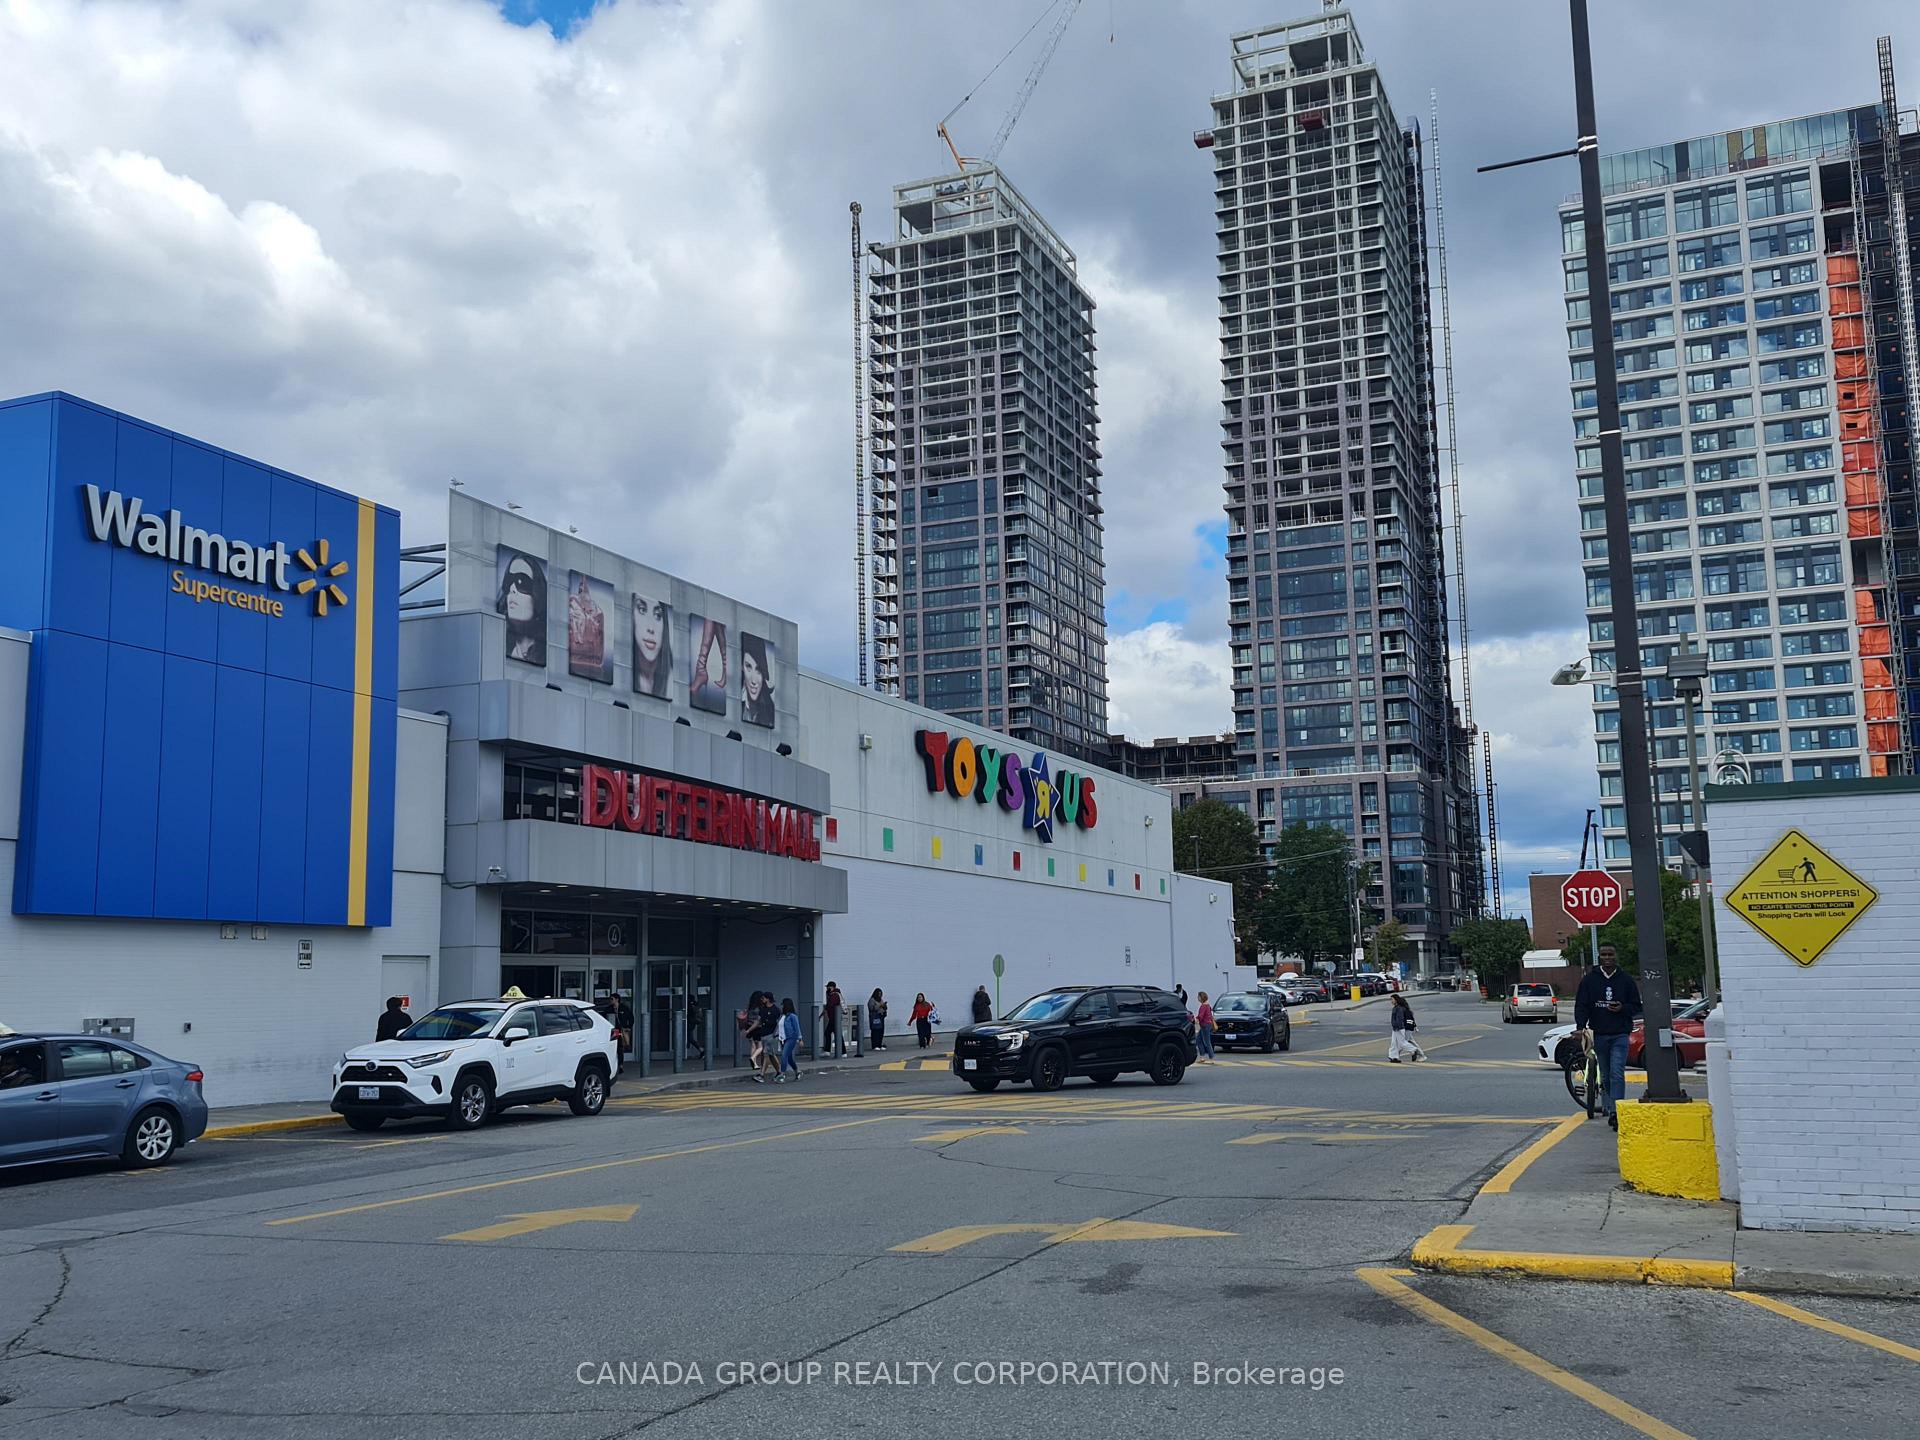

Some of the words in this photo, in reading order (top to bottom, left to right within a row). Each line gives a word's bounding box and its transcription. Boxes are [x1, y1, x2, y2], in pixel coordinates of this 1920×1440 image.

[85, 483, 291, 591] Walmart
[171, 569, 284, 618] Supercentre
[916, 730, 1024, 811] TOYS
[1055, 769, 1098, 829] US
[583, 764, 758, 849] DUFFERIN
[759, 799, 821, 862] MALL
[1566, 886, 1617, 908] STOP
[1742, 891, 1798, 900] ATTENTION
[1800, 889, 1860, 898] SHOPPERS!
[1757, 912, 1792, 920] Shopping
[1828, 910, 1846, 918] Lock
